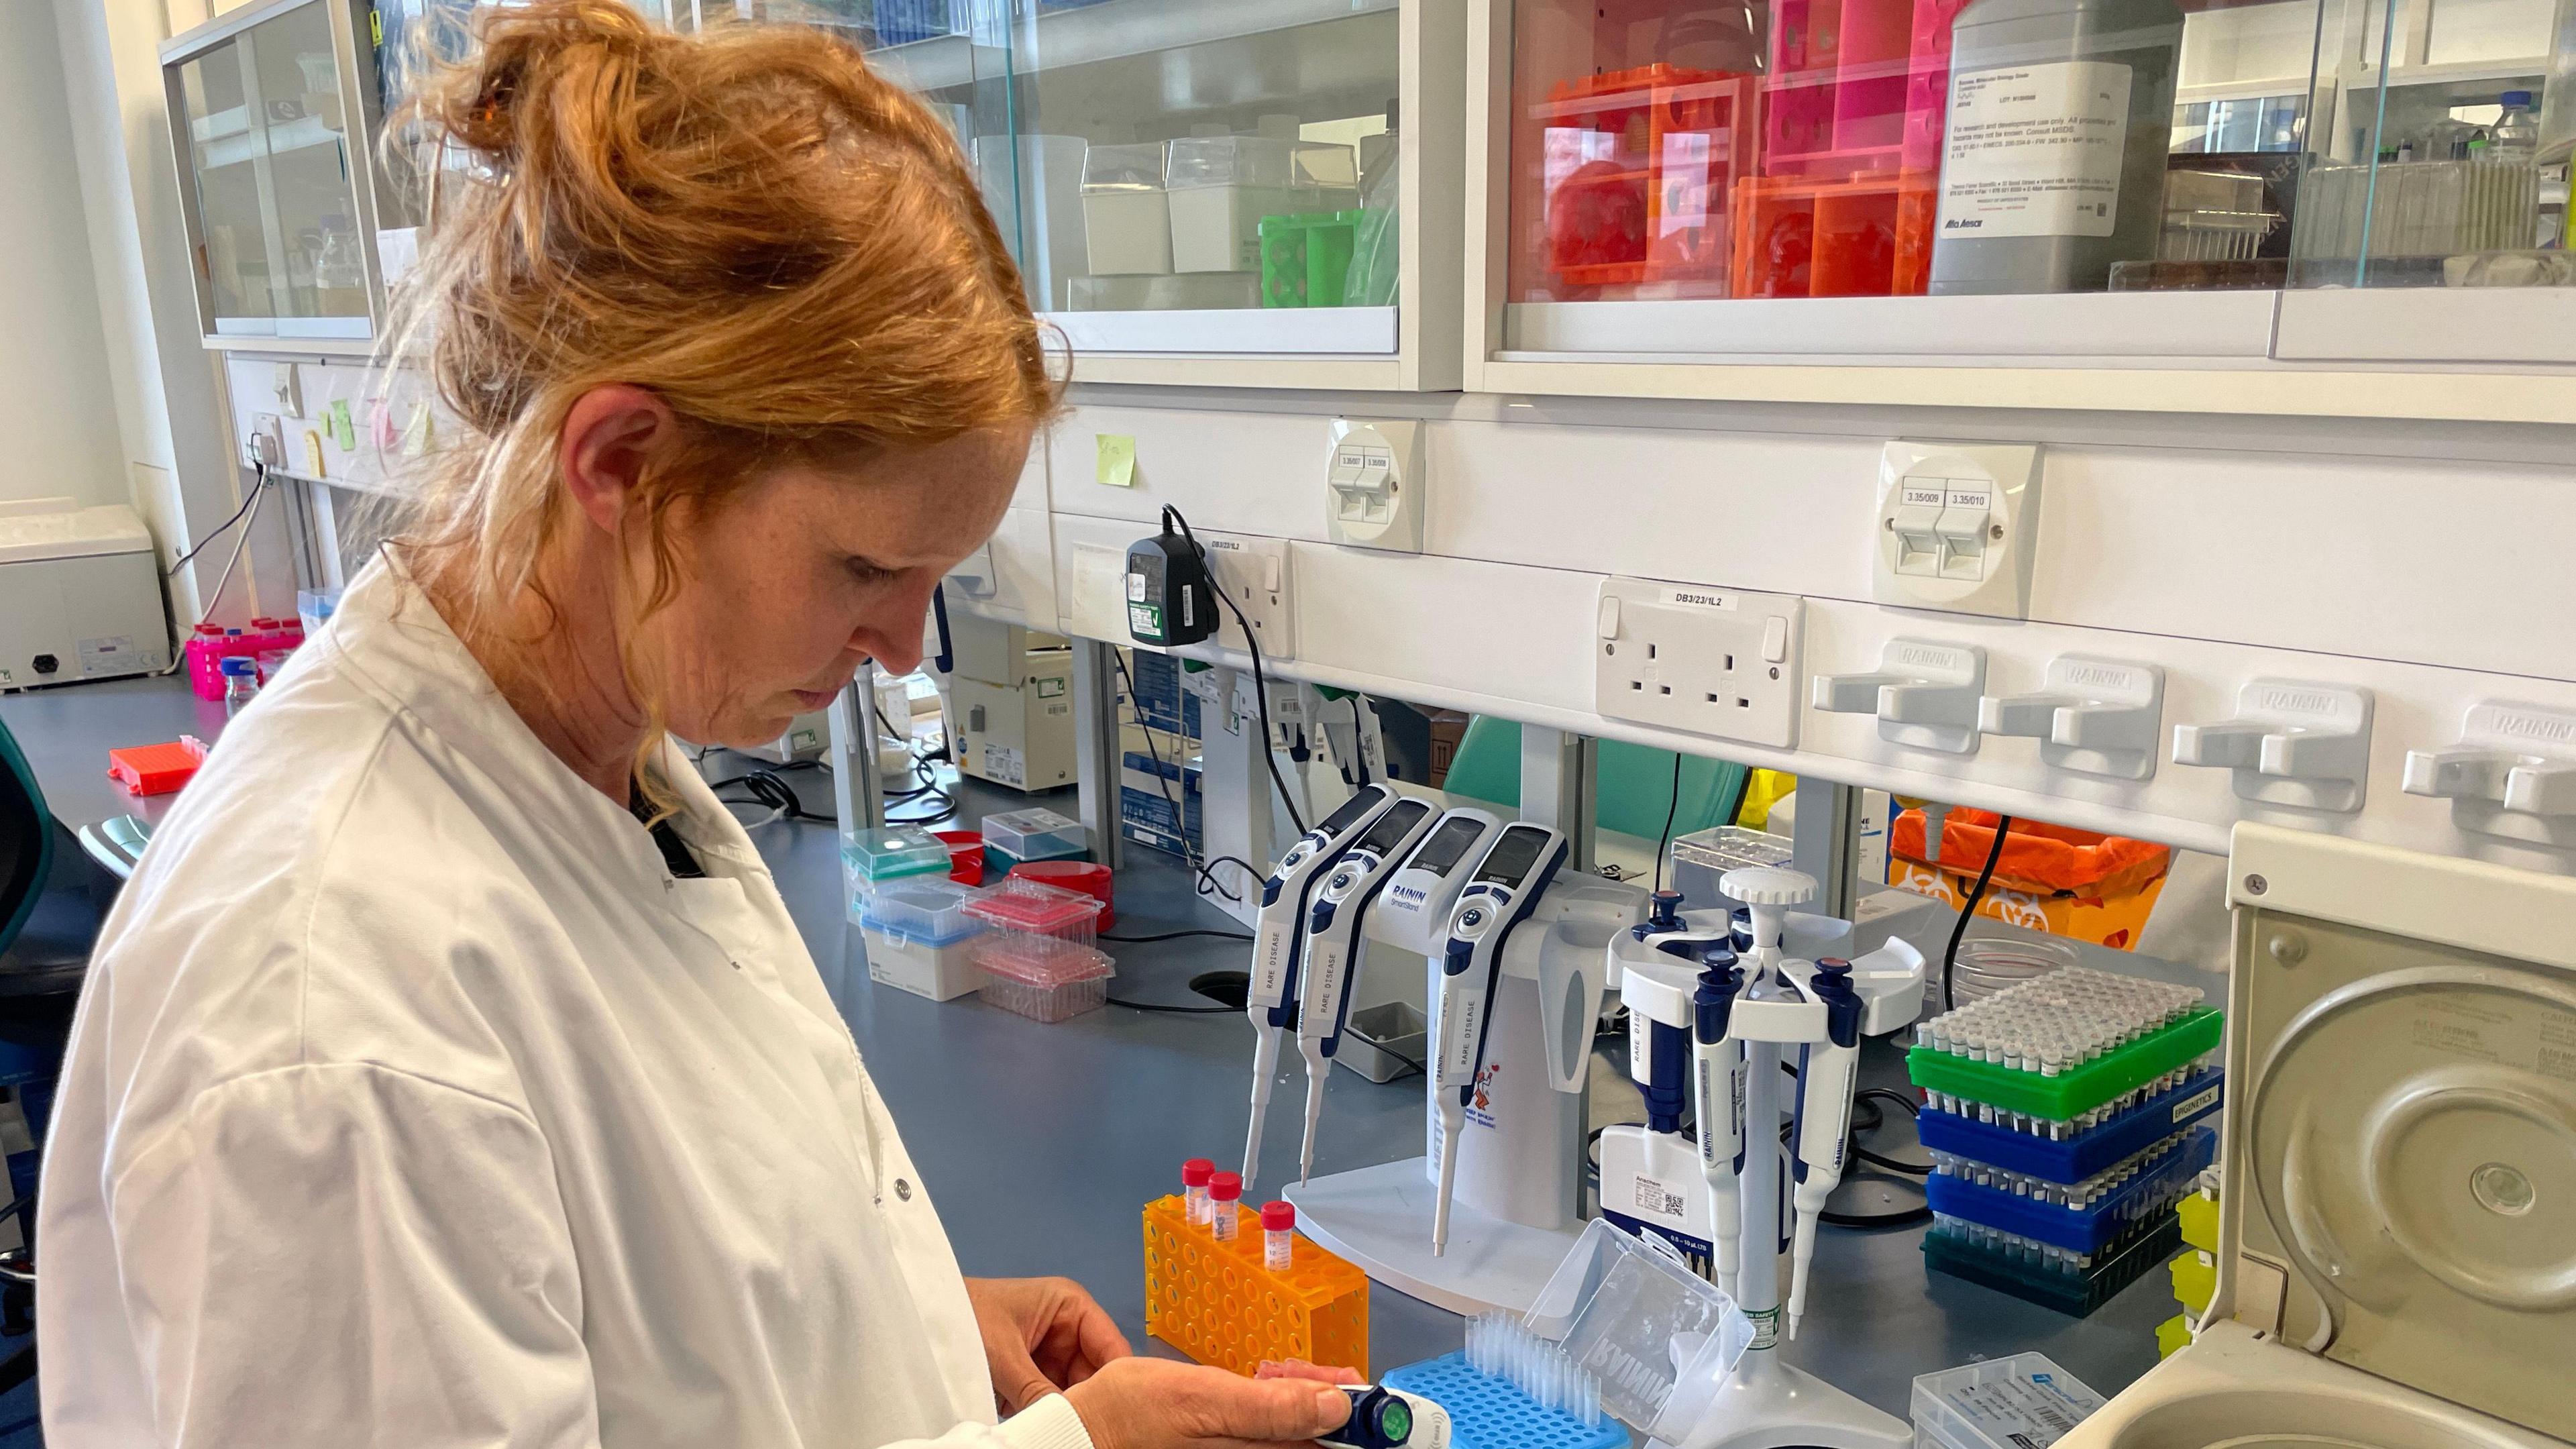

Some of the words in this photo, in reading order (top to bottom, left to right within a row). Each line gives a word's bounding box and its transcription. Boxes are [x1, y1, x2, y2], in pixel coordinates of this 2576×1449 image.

[1960, 219, 1984, 228] Aesar
[1907, 492, 1939, 502] 3.35/009
[1952, 495, 1984, 505] 3.35/010
[1902, 647, 1953, 665] RAININ
[2070, 665, 2126, 685] RAININ
[2267, 691, 2336, 713] RAININ
[1393, 885, 1427, 903] RAININ
[1269, 932, 1280, 965] DISEASE
[1267, 971, 1275, 989] RARE
[1324, 953, 1336, 989] DISEASE
[1320, 994, 1330, 1013] RARE
[1464, 1001, 1475, 1038] DISEASE
[1461, 1044, 1469, 1065] RARE
[2175, 1091, 2212, 1118] EPIGENETICS
[1434, 1100, 1443, 1170] METTLE
[1704, 1132, 1712, 1158] RAININ
